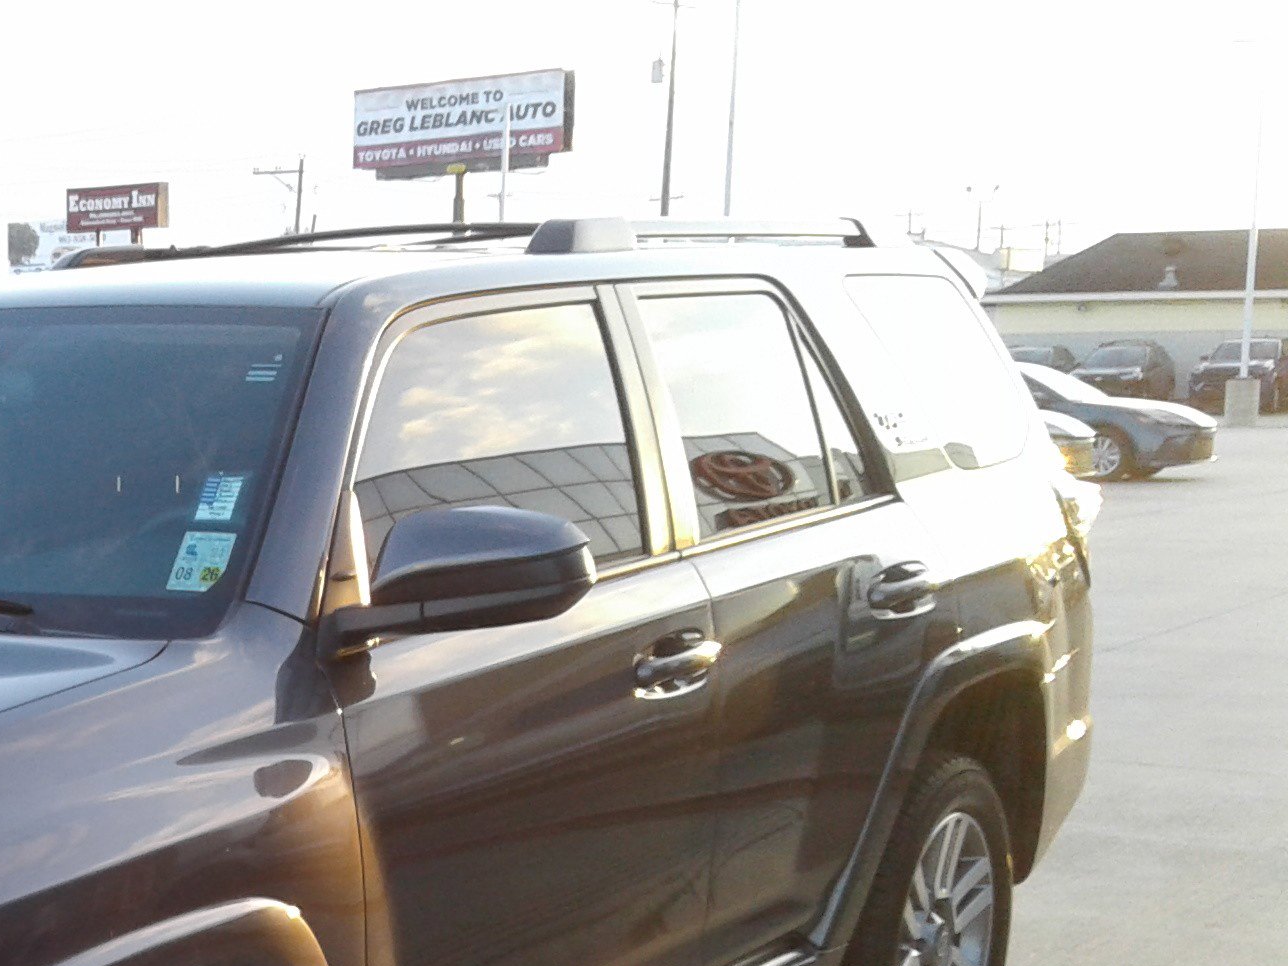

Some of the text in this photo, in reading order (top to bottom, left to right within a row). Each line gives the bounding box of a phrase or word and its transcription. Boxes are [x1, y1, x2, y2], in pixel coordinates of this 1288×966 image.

[406, 90, 503, 111] WELCOME TO
[357, 117, 405, 136] GREG
[409, 109, 498, 131] LEBLANC
[358, 147, 407, 162] TOYOTA
[417, 140, 472, 157] HYUNDAI
[519, 133, 554, 147] CARS
